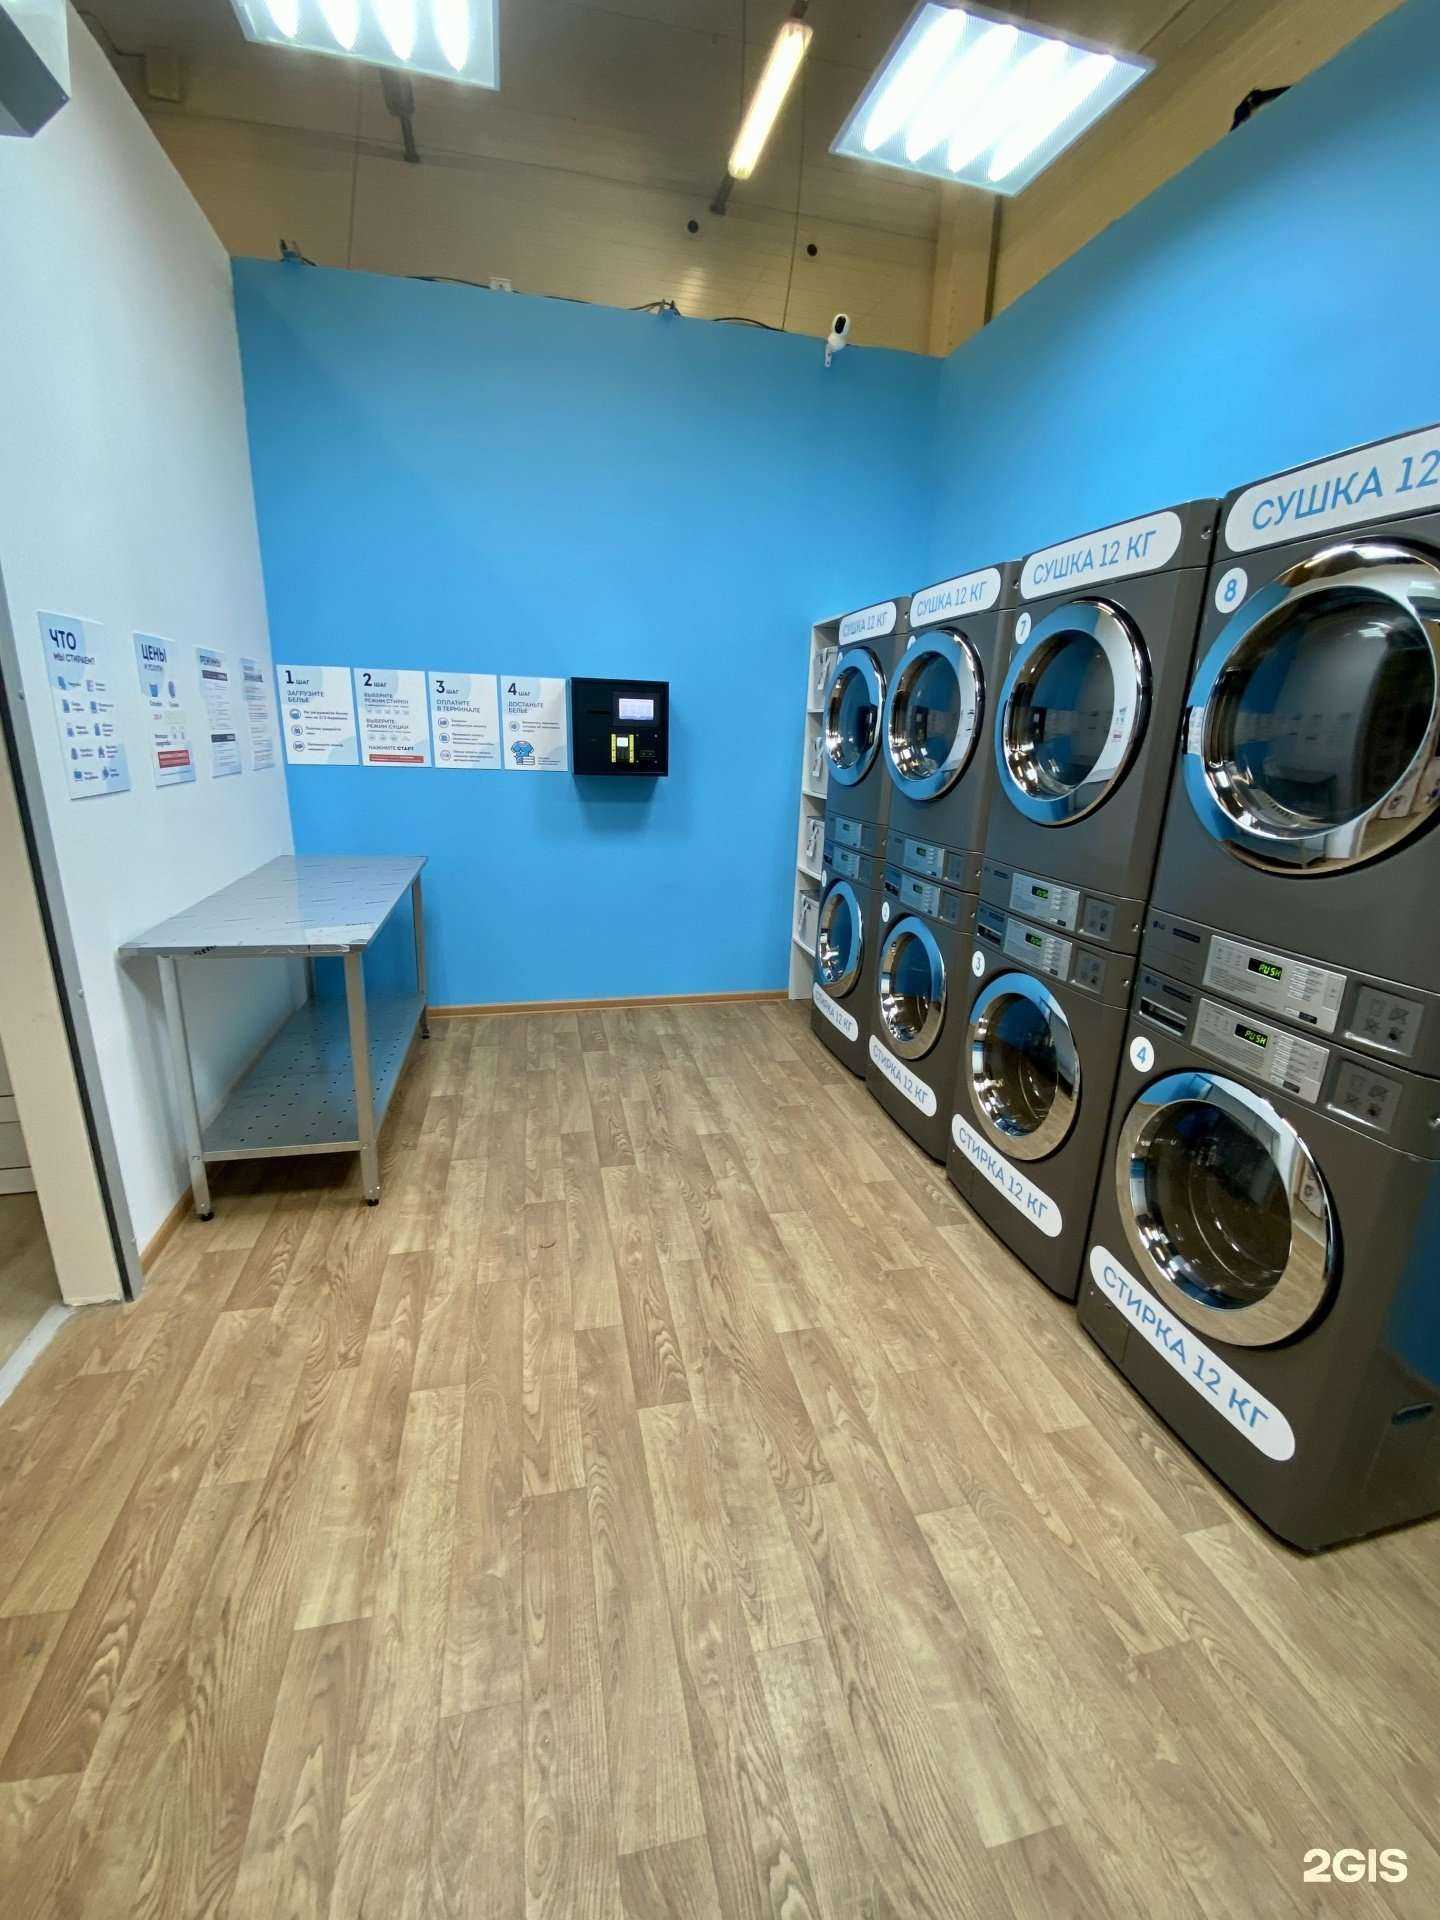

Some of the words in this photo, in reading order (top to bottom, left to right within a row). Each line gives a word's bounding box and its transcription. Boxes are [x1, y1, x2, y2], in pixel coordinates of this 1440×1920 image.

[1252, 466, 1383, 530] СУШКА
[1396, 450, 1440, 493] 12
[1033, 550, 1094, 585] СУШКА
[1099, 540, 1120, 567] 12
[1126, 530, 1157, 561] КГ
[916, 594, 951, 617] СУШКА
[955, 586, 967, 605] 12
[969, 581, 988, 601] КГ
[1224, 579, 1237, 602] 8
[866, 614, 875, 630] 12
[875, 611, 888, 626] КГ
[1021, 619, 1027, 637] 7
[49, 628, 76, 650] ЧТО
[142, 643, 167, 663] ЦЕНЫ
[285, 670, 294, 684] 1
[362, 673, 372, 686] 2
[436, 680, 445, 693] 3
[507, 682, 517, 696] 4
[976, 957, 981, 971] 3
[1258, 963, 1282, 977] PUSH
[835, 1011, 842, 1026] 12
[843, 1020, 852, 1032] КГ
[1244, 1030, 1267, 1045] PUSH
[1136, 1047, 1147, 1064] 4
[873, 1044, 901, 1084] СТИРКА
[903, 1075, 913, 1095] 12
[914, 1087, 928, 1105] КГ
[959, 1127, 1005, 1185] СТИРКА
[1008, 1176, 1023, 1201] 12
[1027, 1193, 1048, 1218] КГ
[1103, 1265, 1187, 1365] СТИРКА
[1192, 1356, 1222, 1395] 12
[1228, 1388, 1269, 1428] КГ
